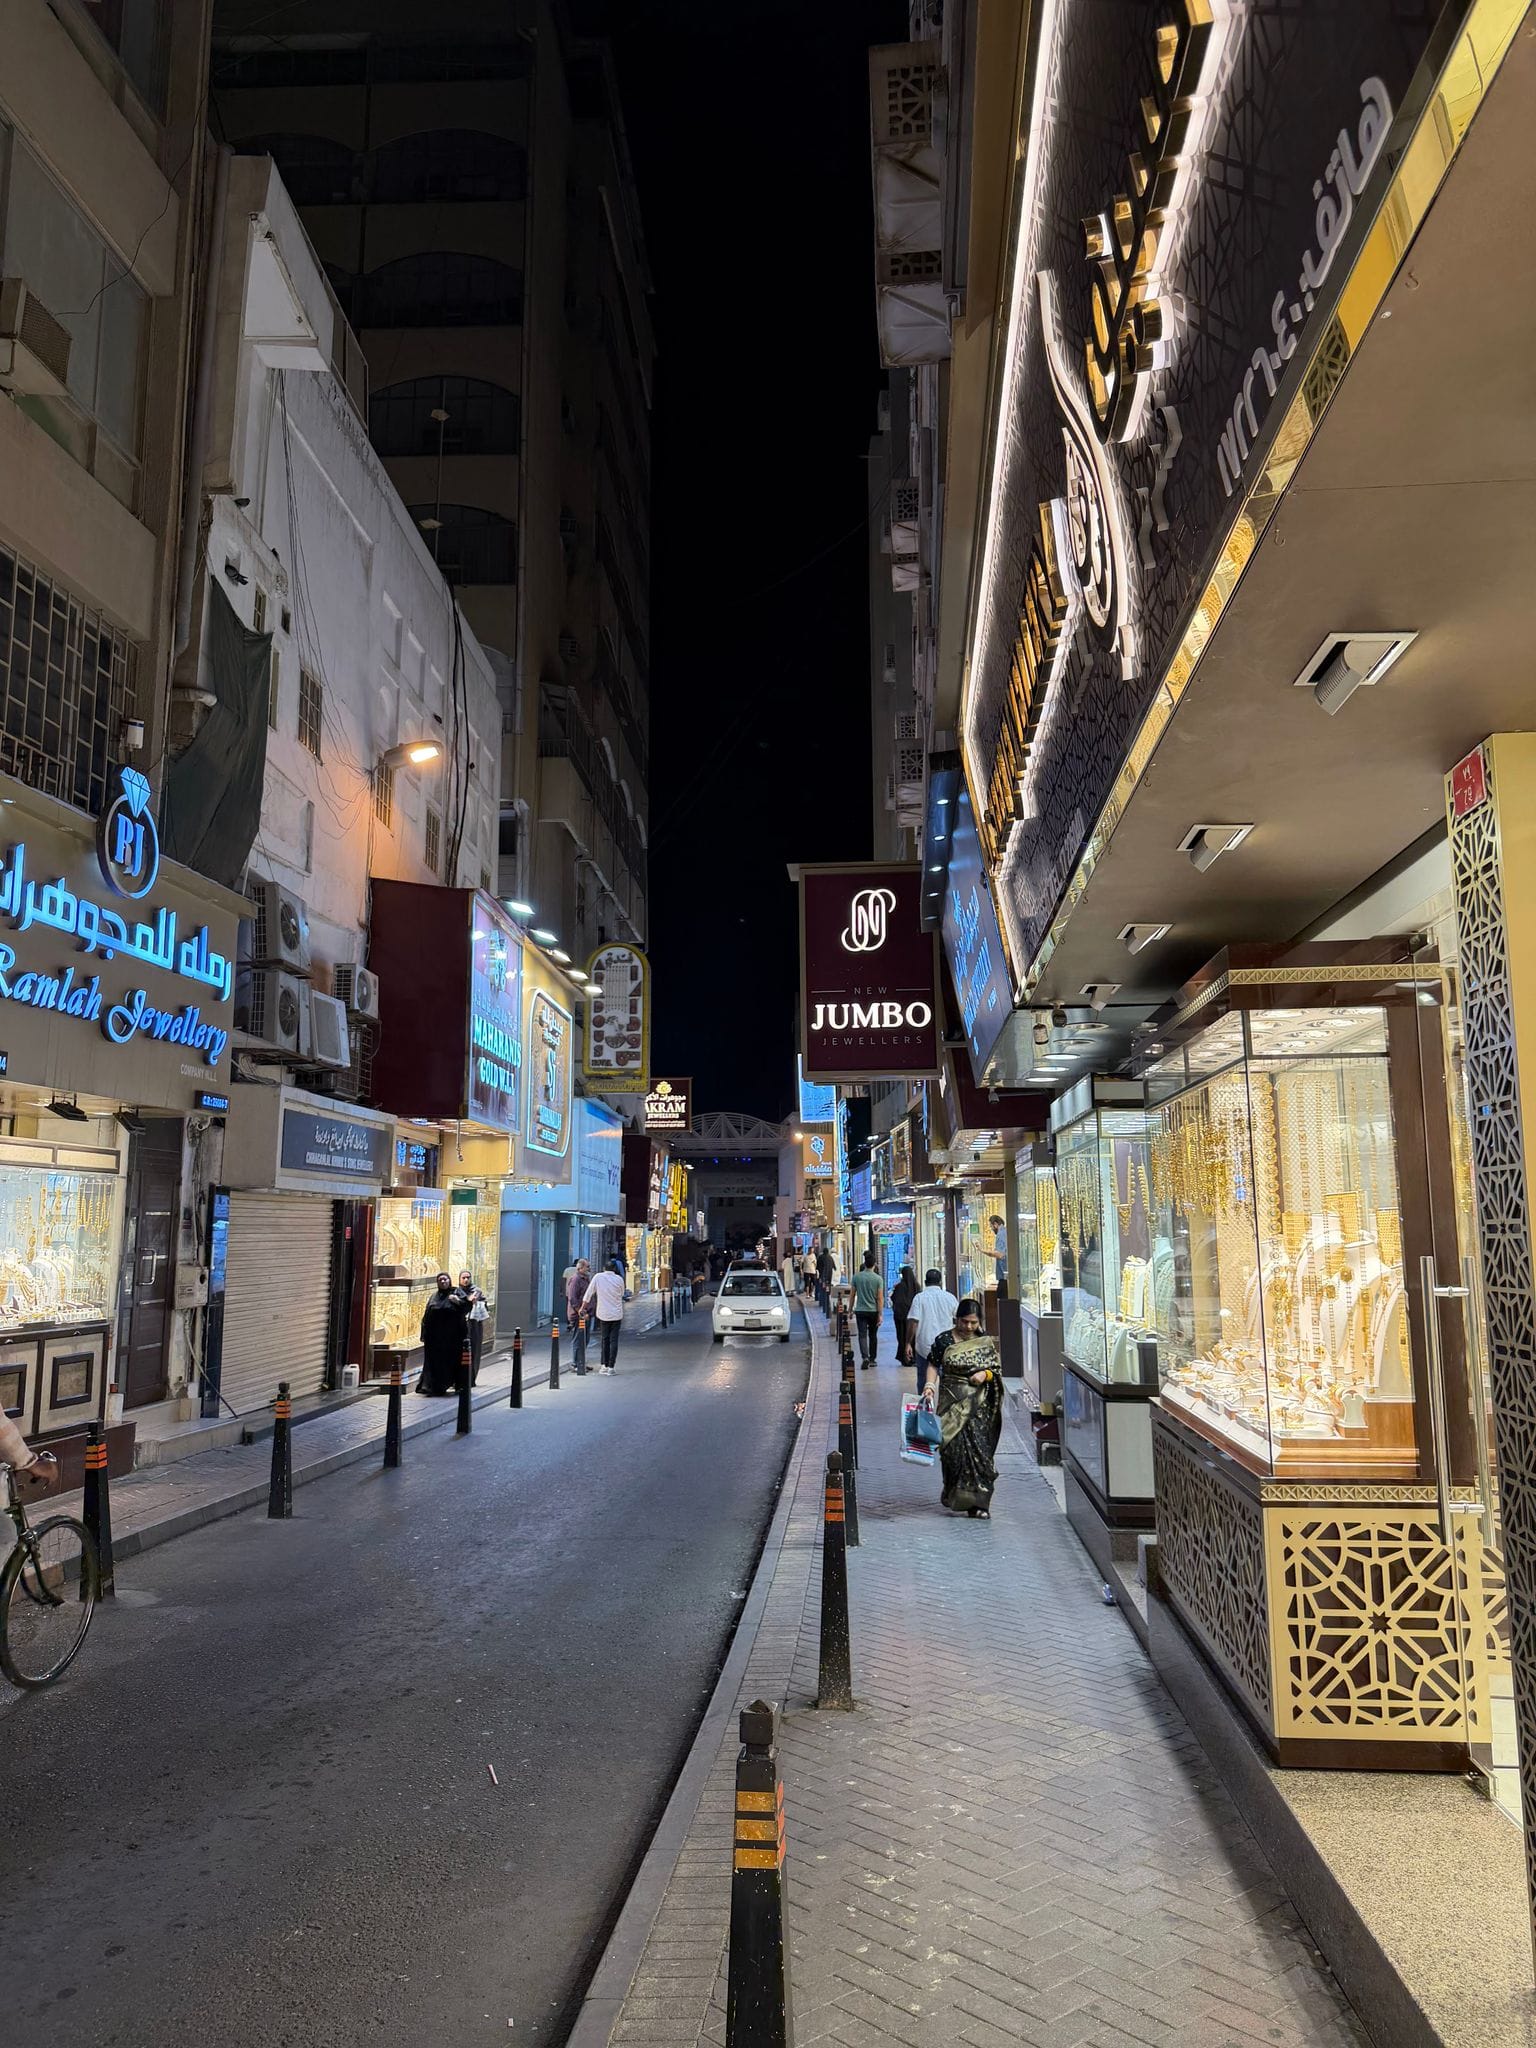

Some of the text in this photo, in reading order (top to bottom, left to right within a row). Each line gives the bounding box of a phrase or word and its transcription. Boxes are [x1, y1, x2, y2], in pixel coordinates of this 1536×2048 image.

[114, 812, 146, 877] RJ
[0, 942, 229, 1066] Ramlah Jewellery
[592, 958, 607, 1058] ARDOUS
[854, 986, 888, 995] NEW
[811, 1002, 932, 1031] JUMBO
[822, 1036, 923, 1046] JEWELLERS
